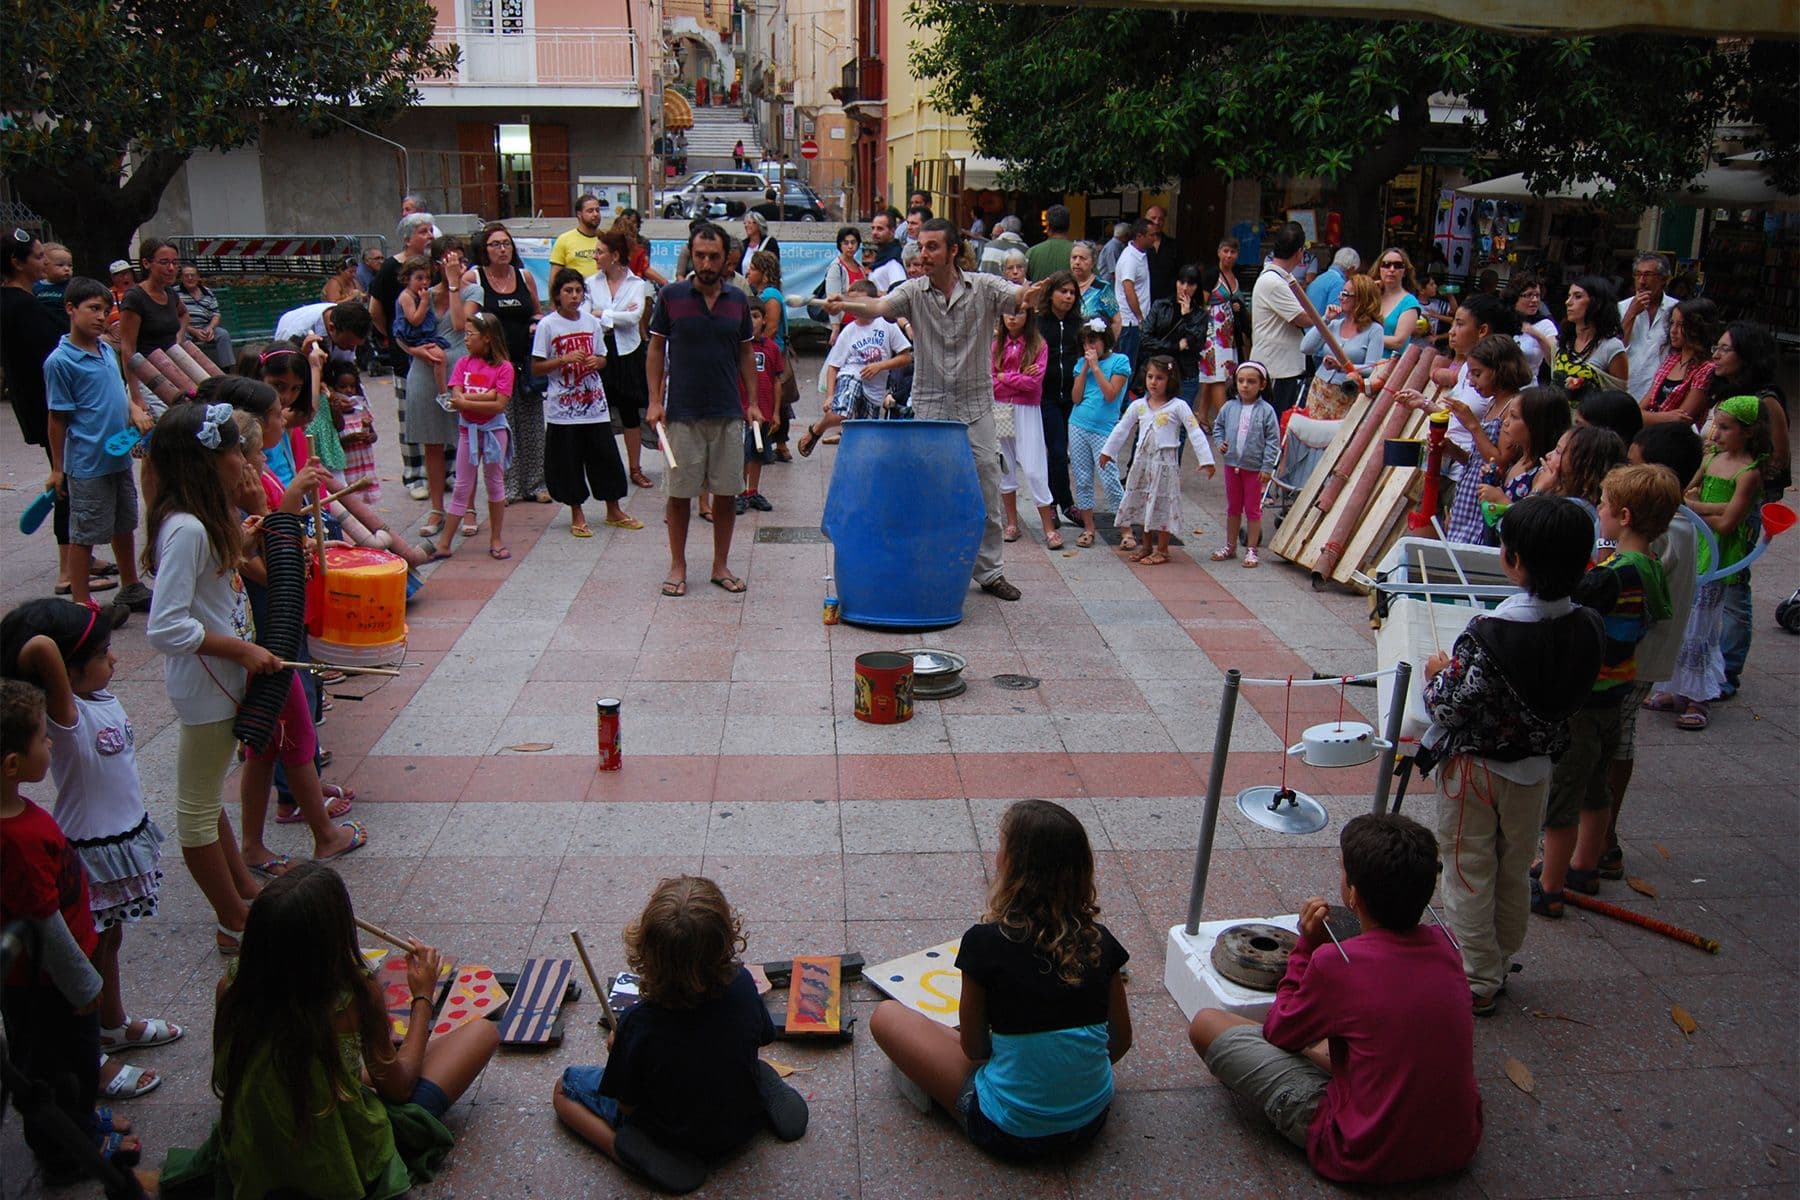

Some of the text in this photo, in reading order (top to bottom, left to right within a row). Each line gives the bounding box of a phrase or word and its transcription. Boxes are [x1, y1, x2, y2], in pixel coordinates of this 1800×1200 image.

[873, 329, 885, 338] 76
[852, 337, 885, 350] ROARING
[463, 371, 471, 386] I
